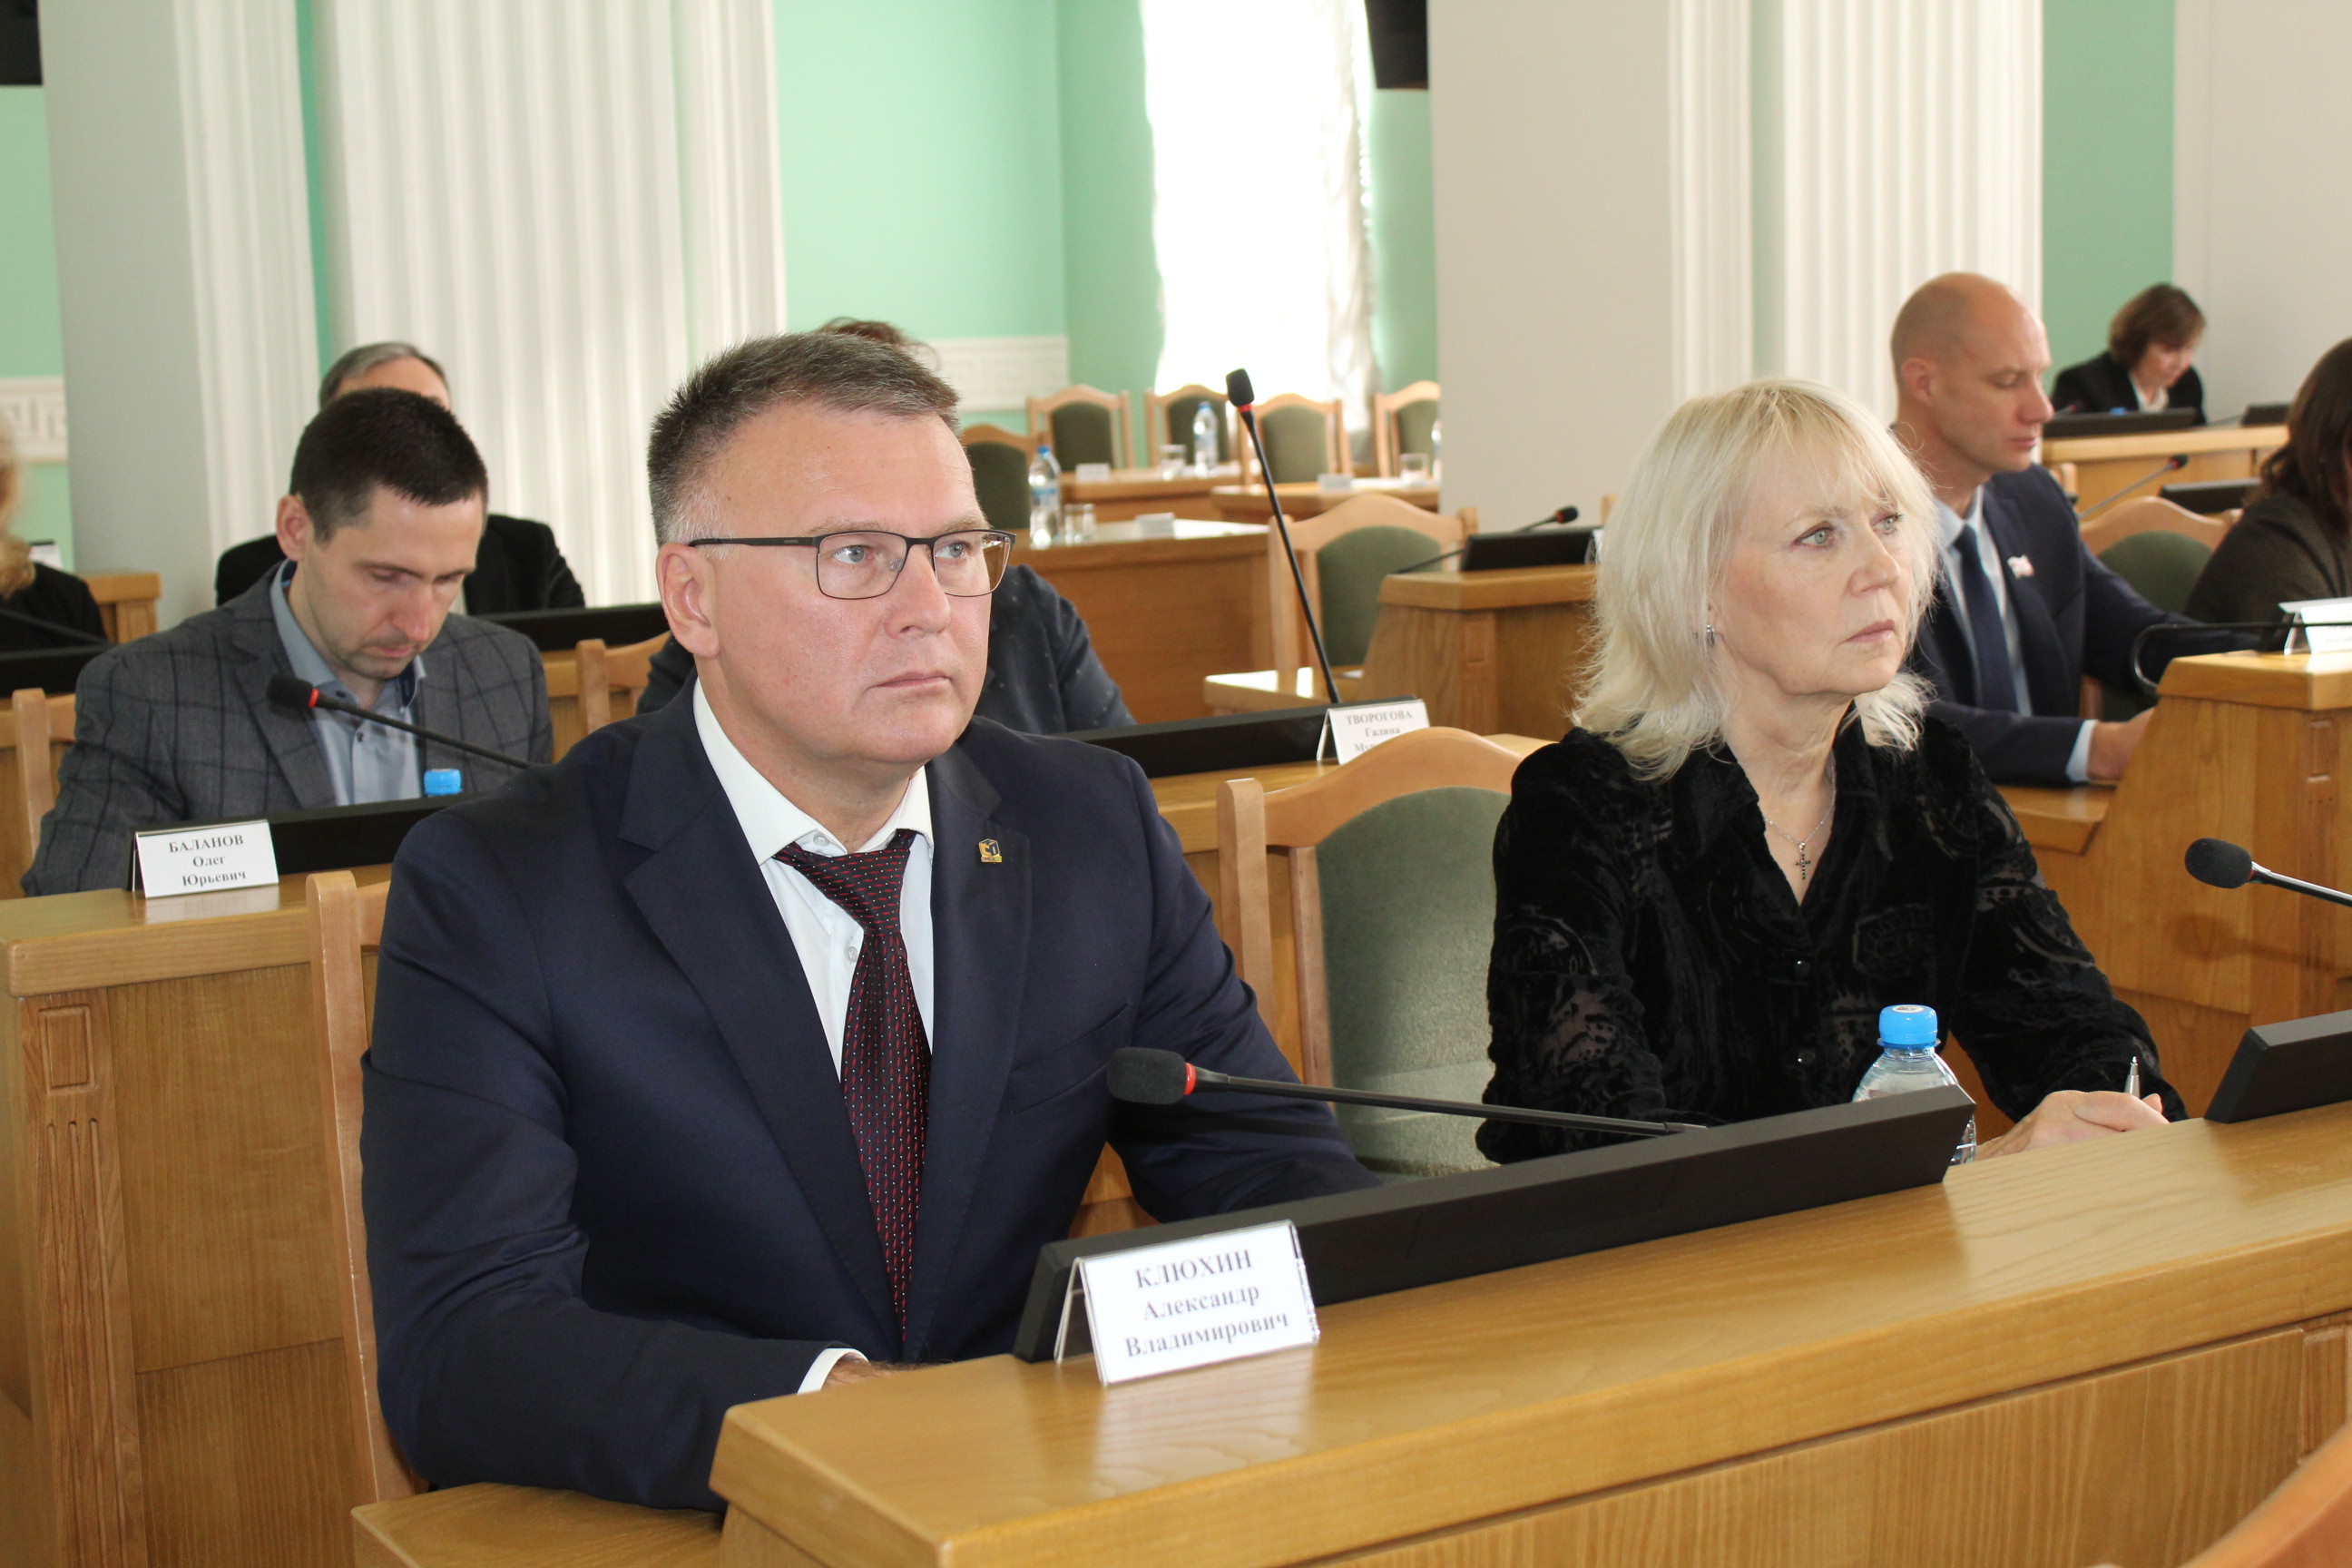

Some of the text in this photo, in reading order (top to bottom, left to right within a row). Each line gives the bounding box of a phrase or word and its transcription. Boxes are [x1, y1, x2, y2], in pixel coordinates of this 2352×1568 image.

[1345, 710, 1413, 725] ТВОРОГОВА
[168, 834, 244, 853] БАЛАНОВ
[192, 856, 225, 867] Олег
[181, 870, 246, 887] Юрьевич
[1134, 1249, 1252, 1289] КЛЮХИН
[1142, 1285, 1259, 1321] Александр
[1124, 1312, 1289, 1357] Владимирович
